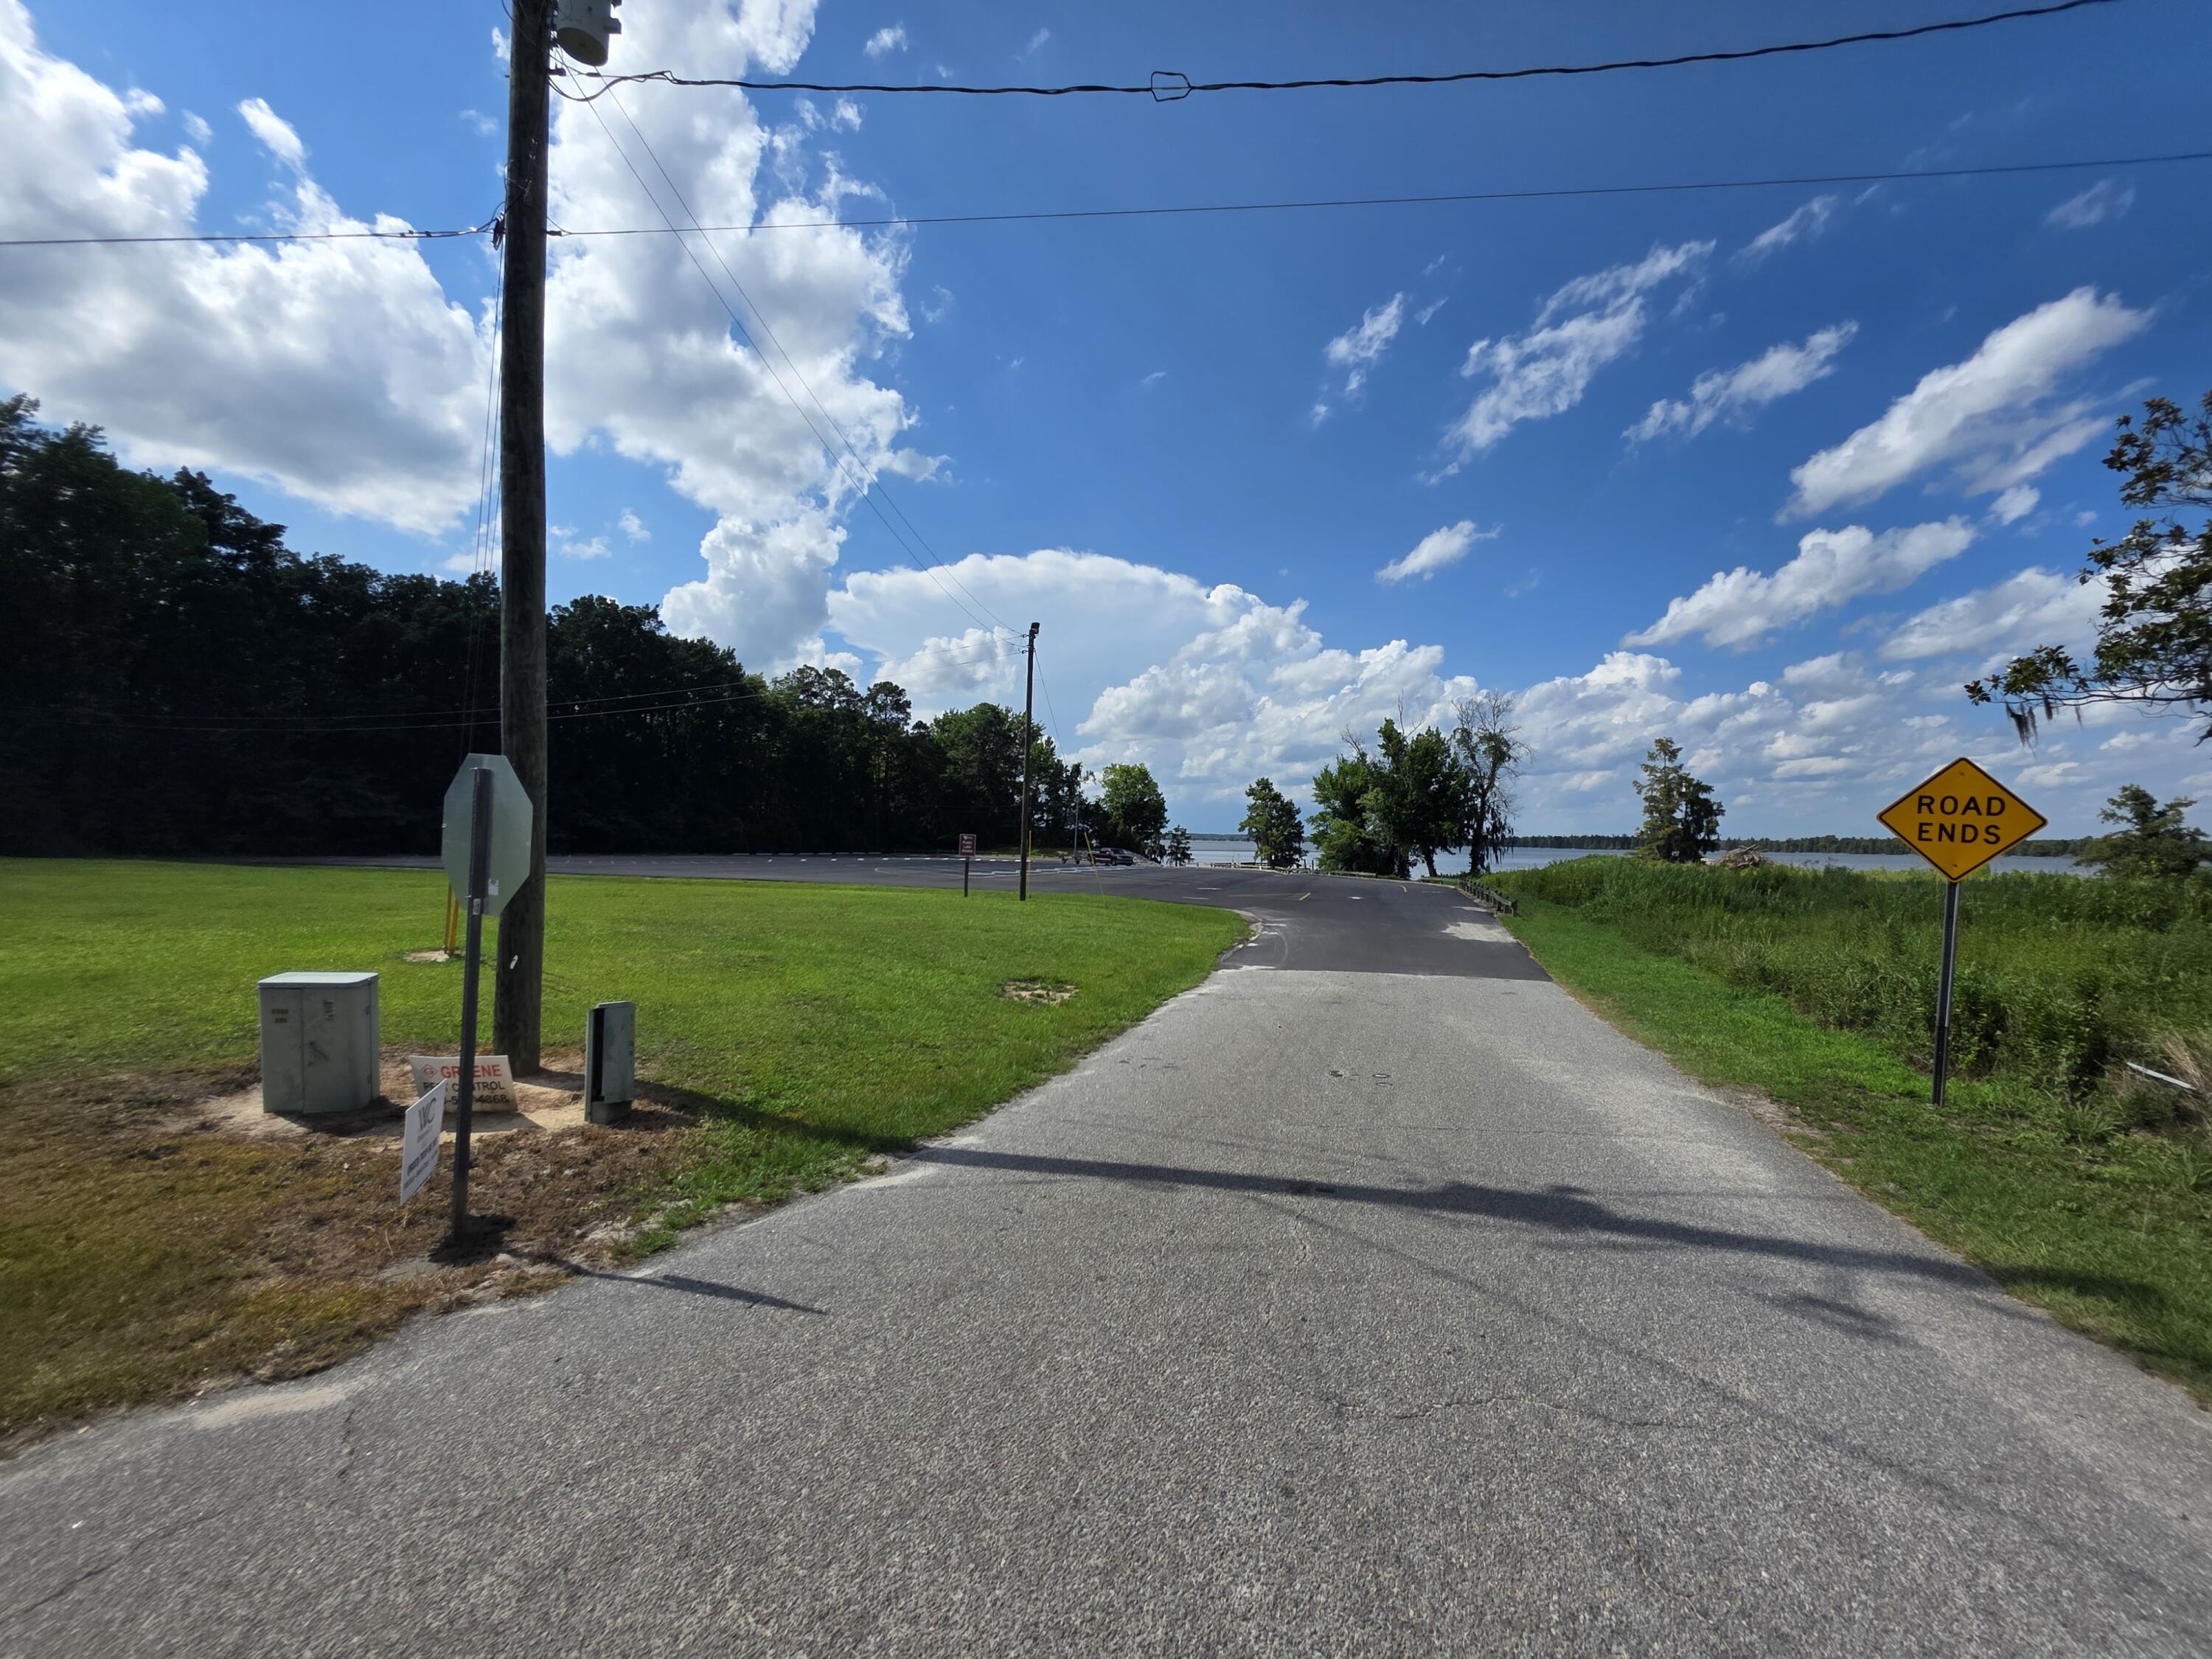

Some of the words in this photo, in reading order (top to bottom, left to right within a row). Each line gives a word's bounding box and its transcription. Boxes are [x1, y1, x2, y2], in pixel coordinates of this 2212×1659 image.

[1917, 795, 2006, 816] ROAD
[1917, 822, 2000, 845] ENDS
[440, 1064, 502, 1079] GRENE
[451, 1081, 505, 1092] CTROL
